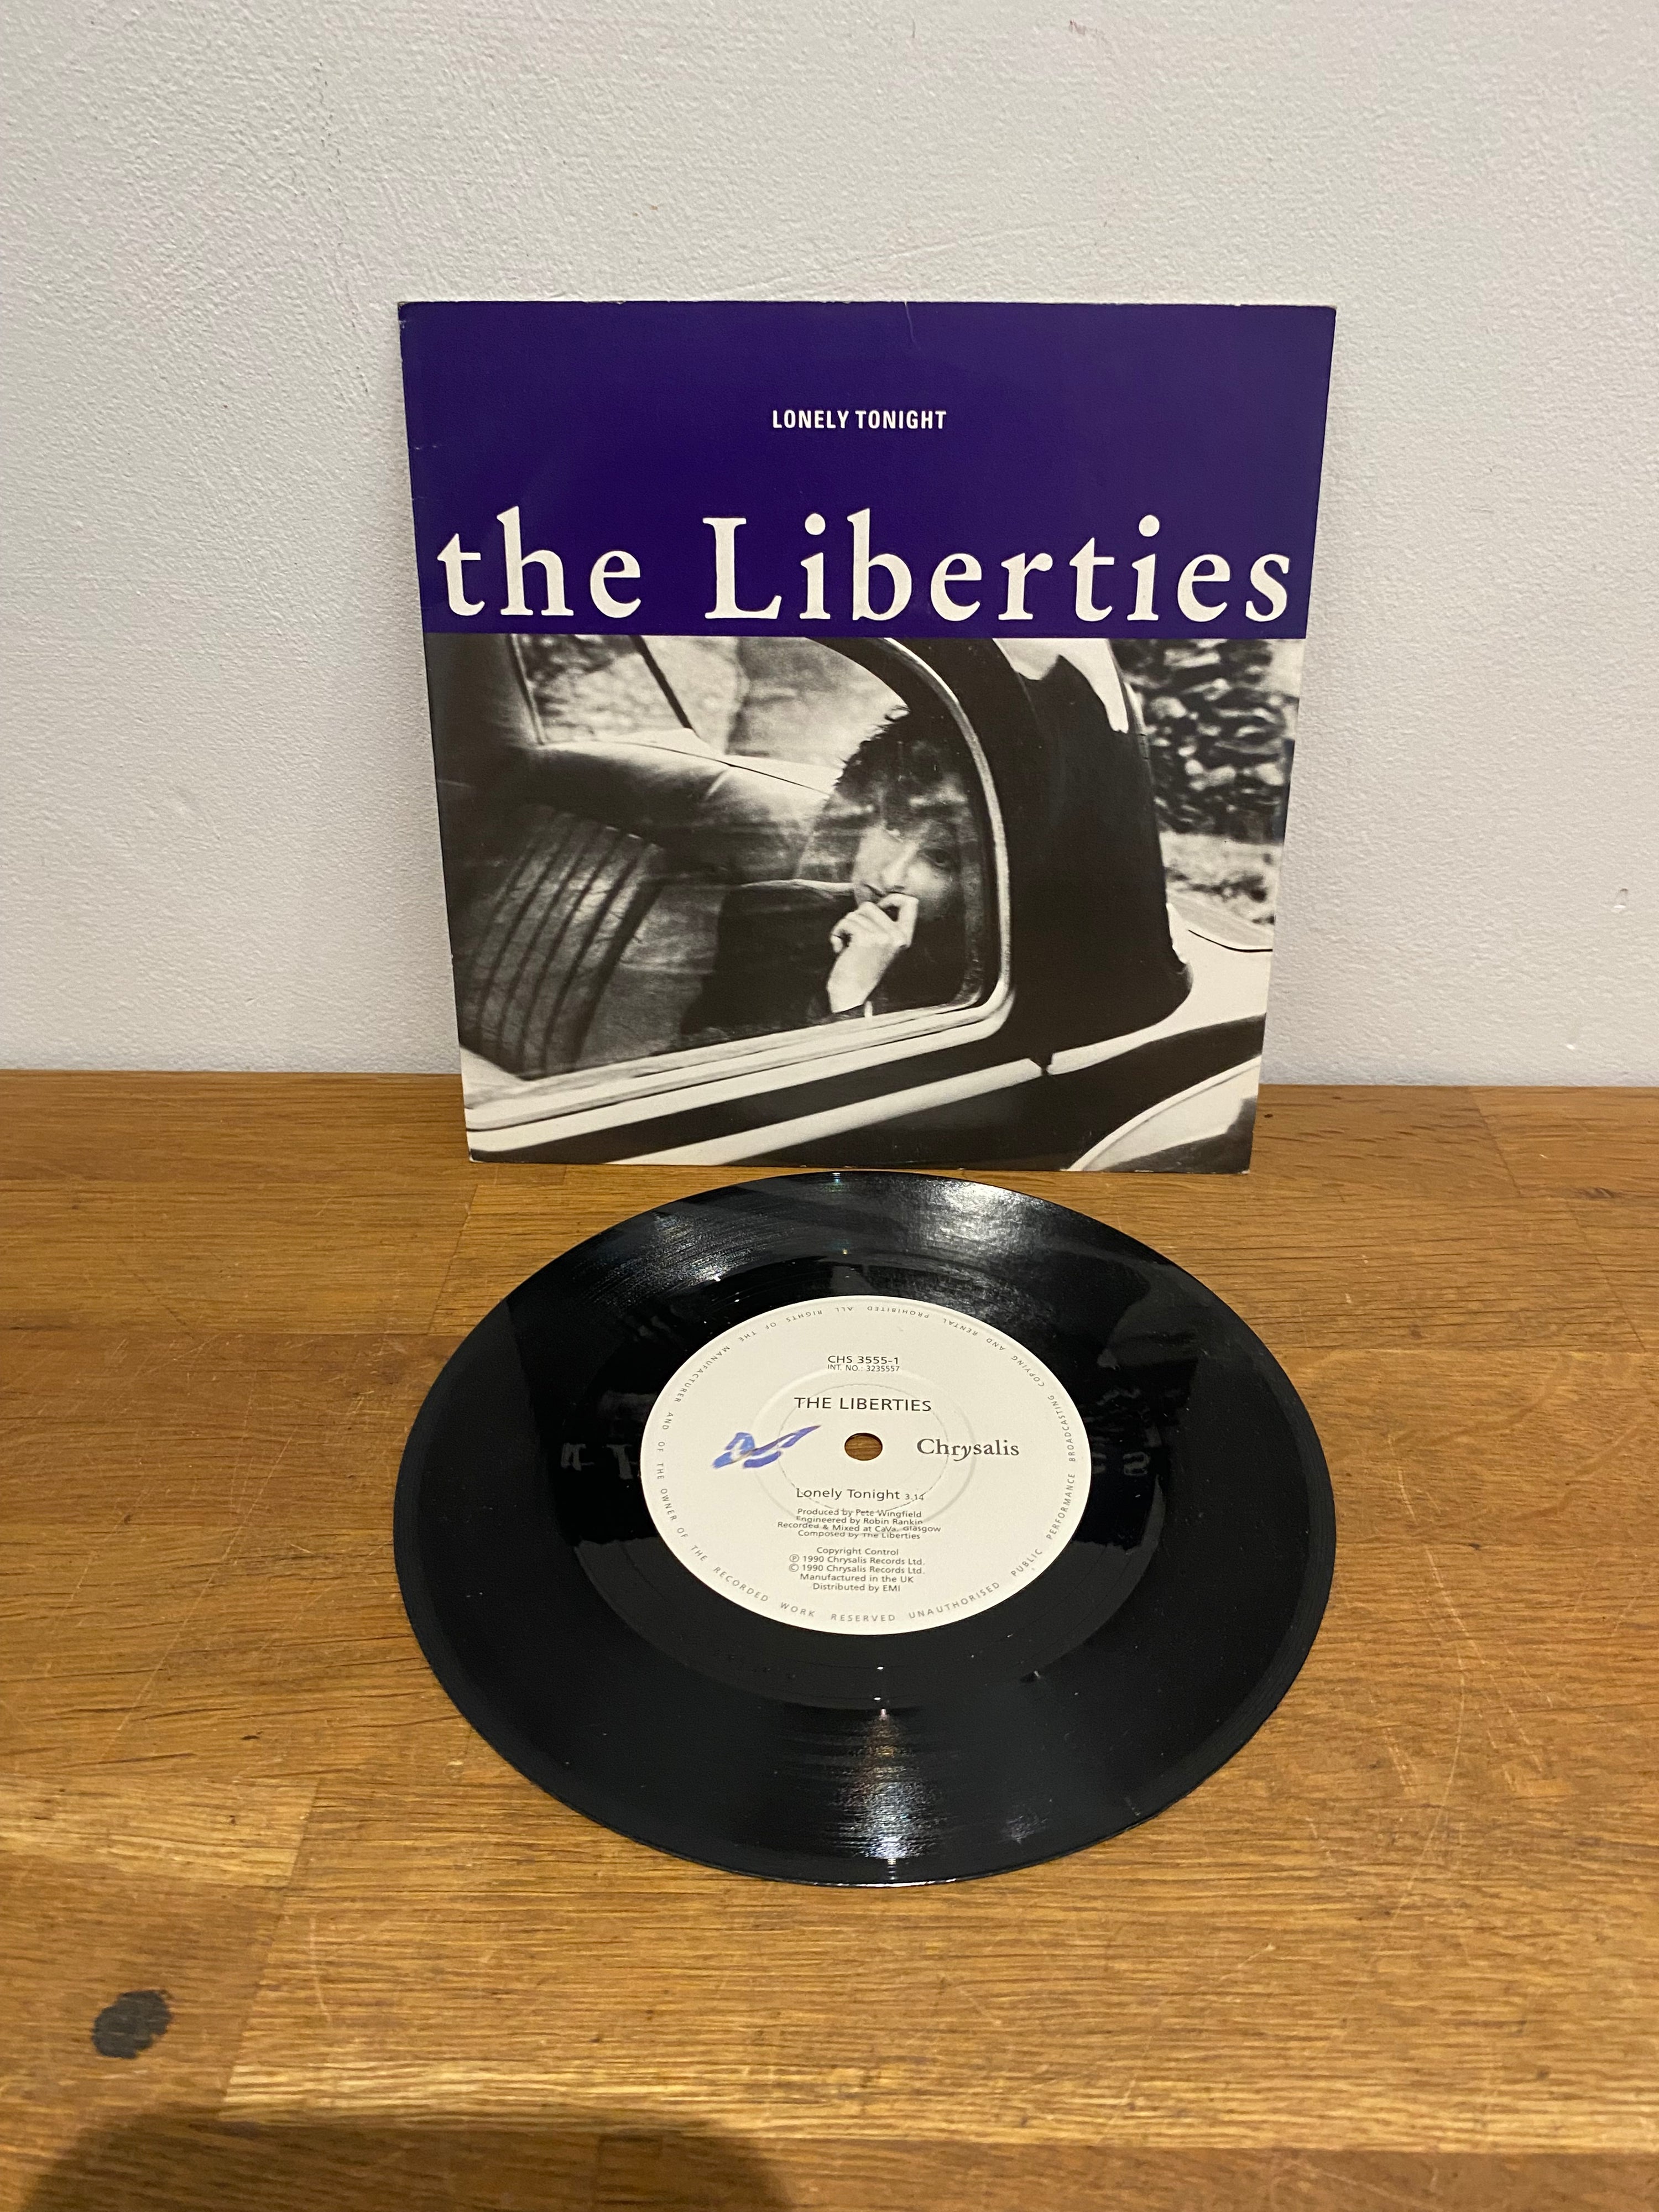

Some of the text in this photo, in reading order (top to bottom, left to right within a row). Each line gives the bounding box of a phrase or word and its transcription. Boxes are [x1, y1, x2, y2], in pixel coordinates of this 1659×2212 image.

[773, 410, 947, 430] LONELY TONIGHT
[436, 505, 1291, 621] the Liberties
[786, 1310, 822, 1322] RIGHTS
[867, 1306, 929, 1318] PROHIBITED
[943, 1318, 978, 1336] RENTAL
[738, 1331, 757, 1342] THE
[986, 1338, 1005, 1350] AND
[828, 1355, 853, 1364] CHS
[674, 1345, 731, 1402] MANUFACTURER
[1011, 1355, 1045, 1387] COPYING
[794, 1397, 931, 1411] THE LIBERTIES
[662, 1412, 674, 1430] AND
[1047, 1395, 1076, 1462] BROADCASTING
[658, 1441, 665, 1452] OF
[917, 1439, 1019, 1461] Chrysalis
[797, 1488, 842, 1500] Lonely
[847, 1489, 900, 1501] Tonight
[660, 1489, 677, 1520] OWNER
[1046, 1474, 1075, 1540] PERFORMANCE
[677, 1527, 688, 1538] OF
[691, 1545, 707, 1561] THE
[817, 1547, 861, 1556] Copyright
[827, 1556, 867, 1565] Chrysalis
[1011, 1548, 1042, 1577] PUBLIC
[827, 1565, 866, 1574] Chrysalis
[713, 1566, 768, 1601] RECORDED
[800, 1573, 866, 1582] Manufactured
[909, 1582, 999, 1619] UNAUTHORISED
[780, 1602, 815, 1617] WORK
